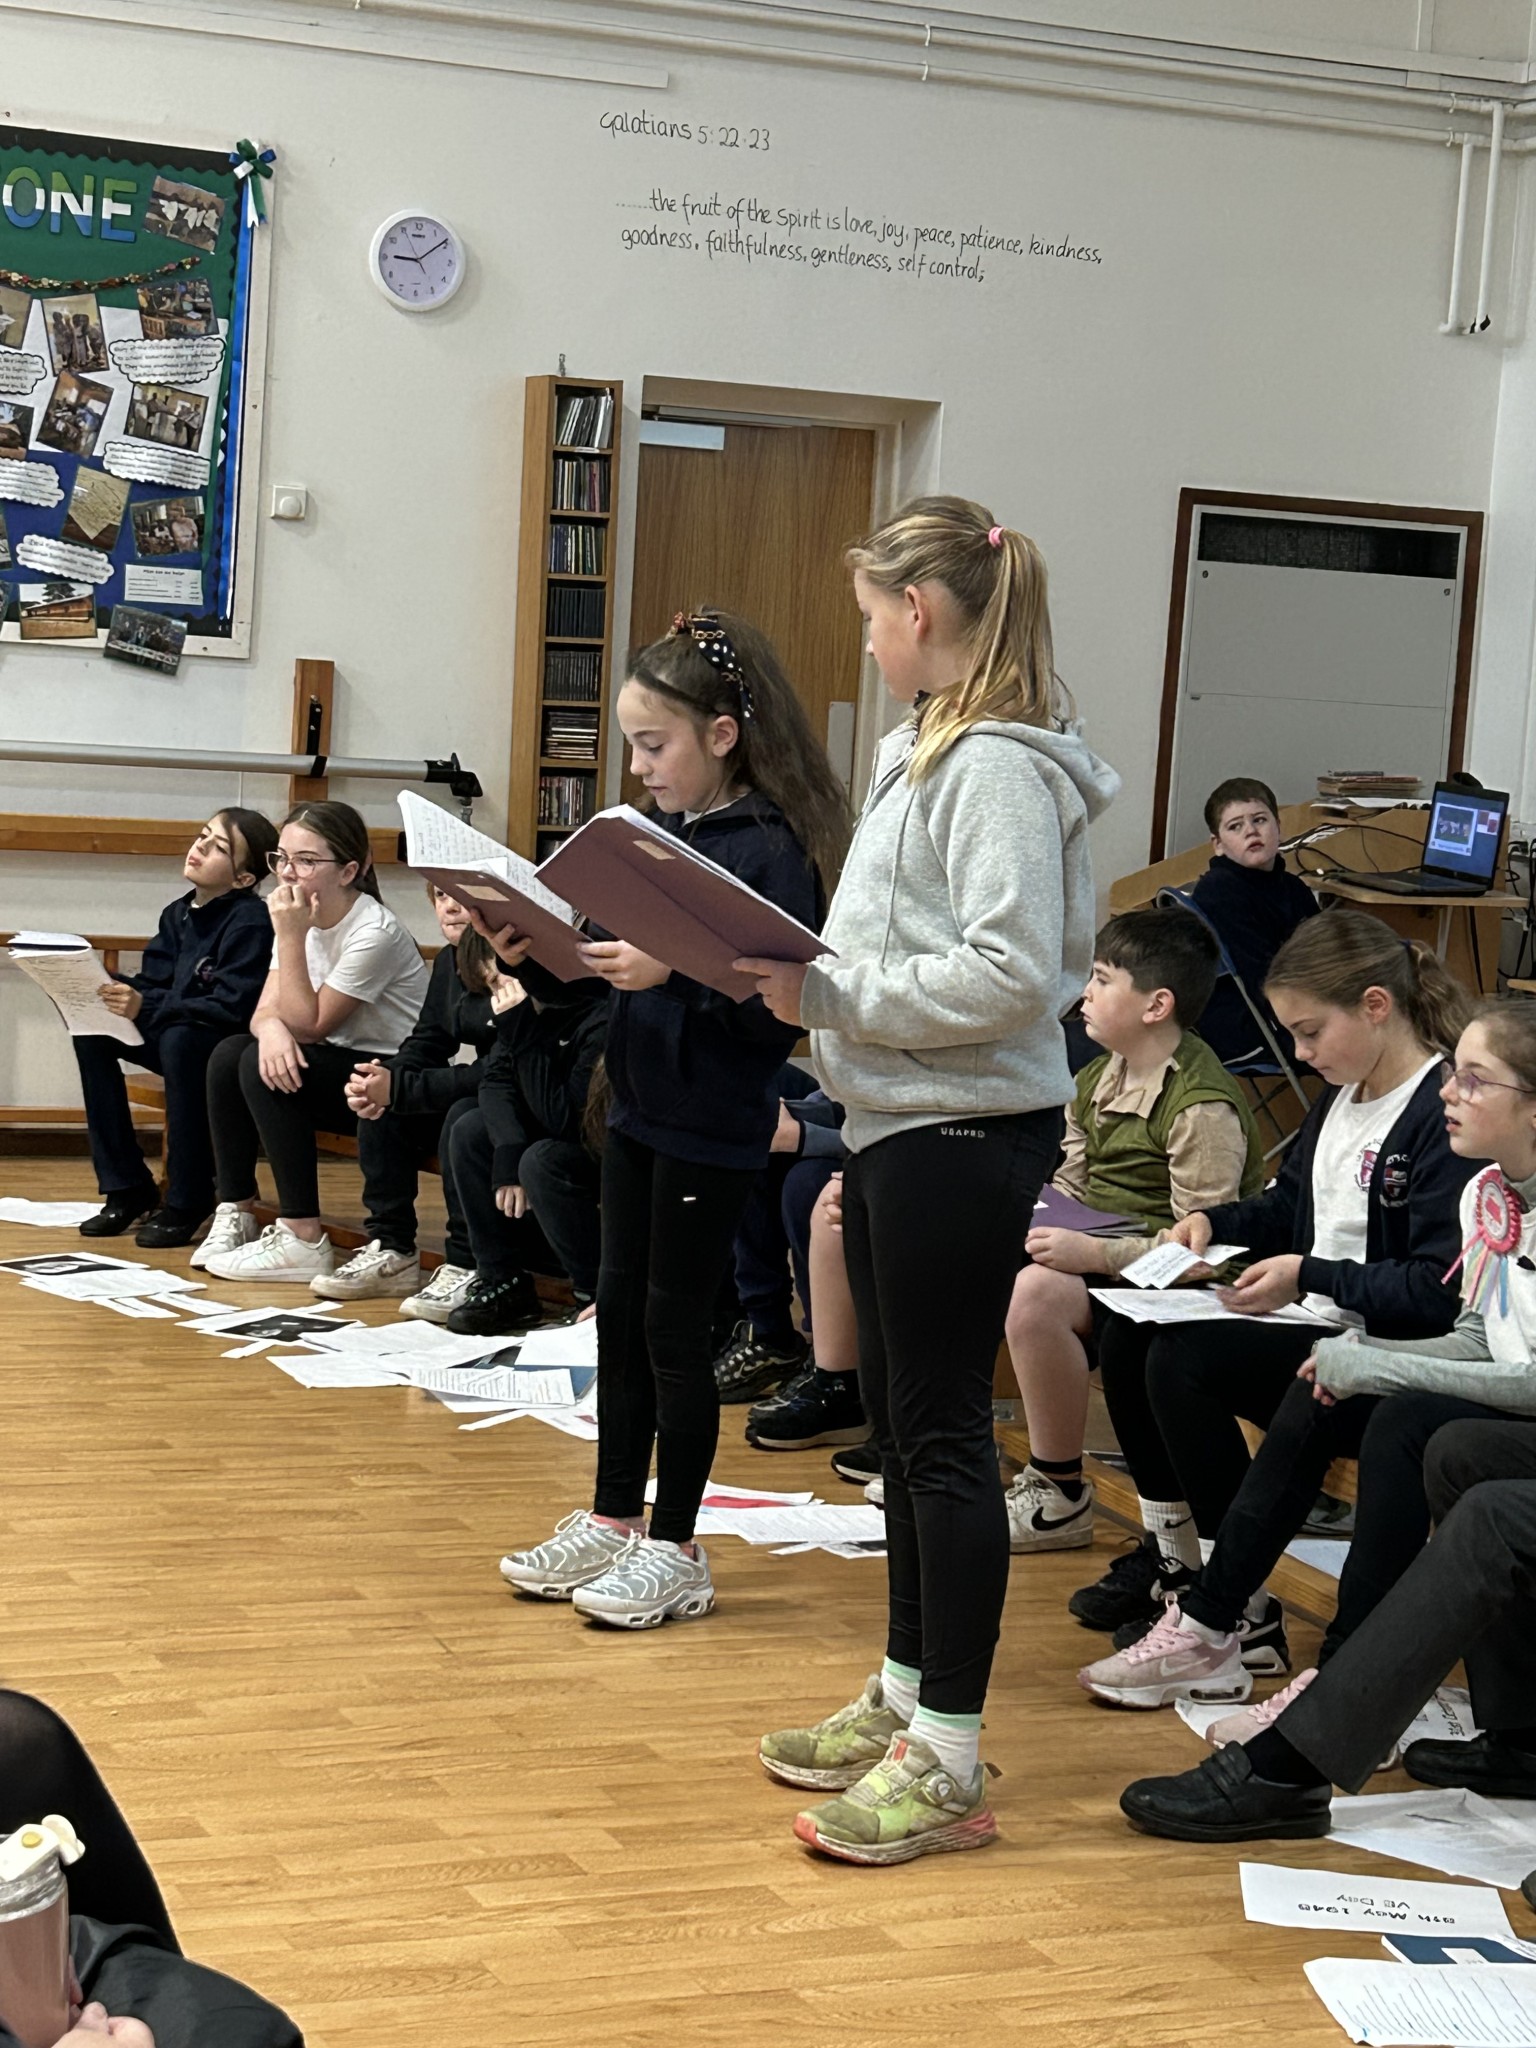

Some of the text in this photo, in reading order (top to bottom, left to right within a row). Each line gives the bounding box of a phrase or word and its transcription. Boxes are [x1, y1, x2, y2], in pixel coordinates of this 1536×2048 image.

[600, 109, 692, 139] Galatians
[681, 192, 721, 226] fruit
[727, 198, 745, 230] of
[748, 198, 772, 224] the
[827, 212, 840, 230] is
[845, 206, 877, 237] love,
[914, 227, 955, 253] peace,
[960, 225, 1023, 256] patience,
[1029, 233, 1102, 264] kindness,
[811, 243, 892, 272] gentleness,
[898, 252, 926, 279] self
